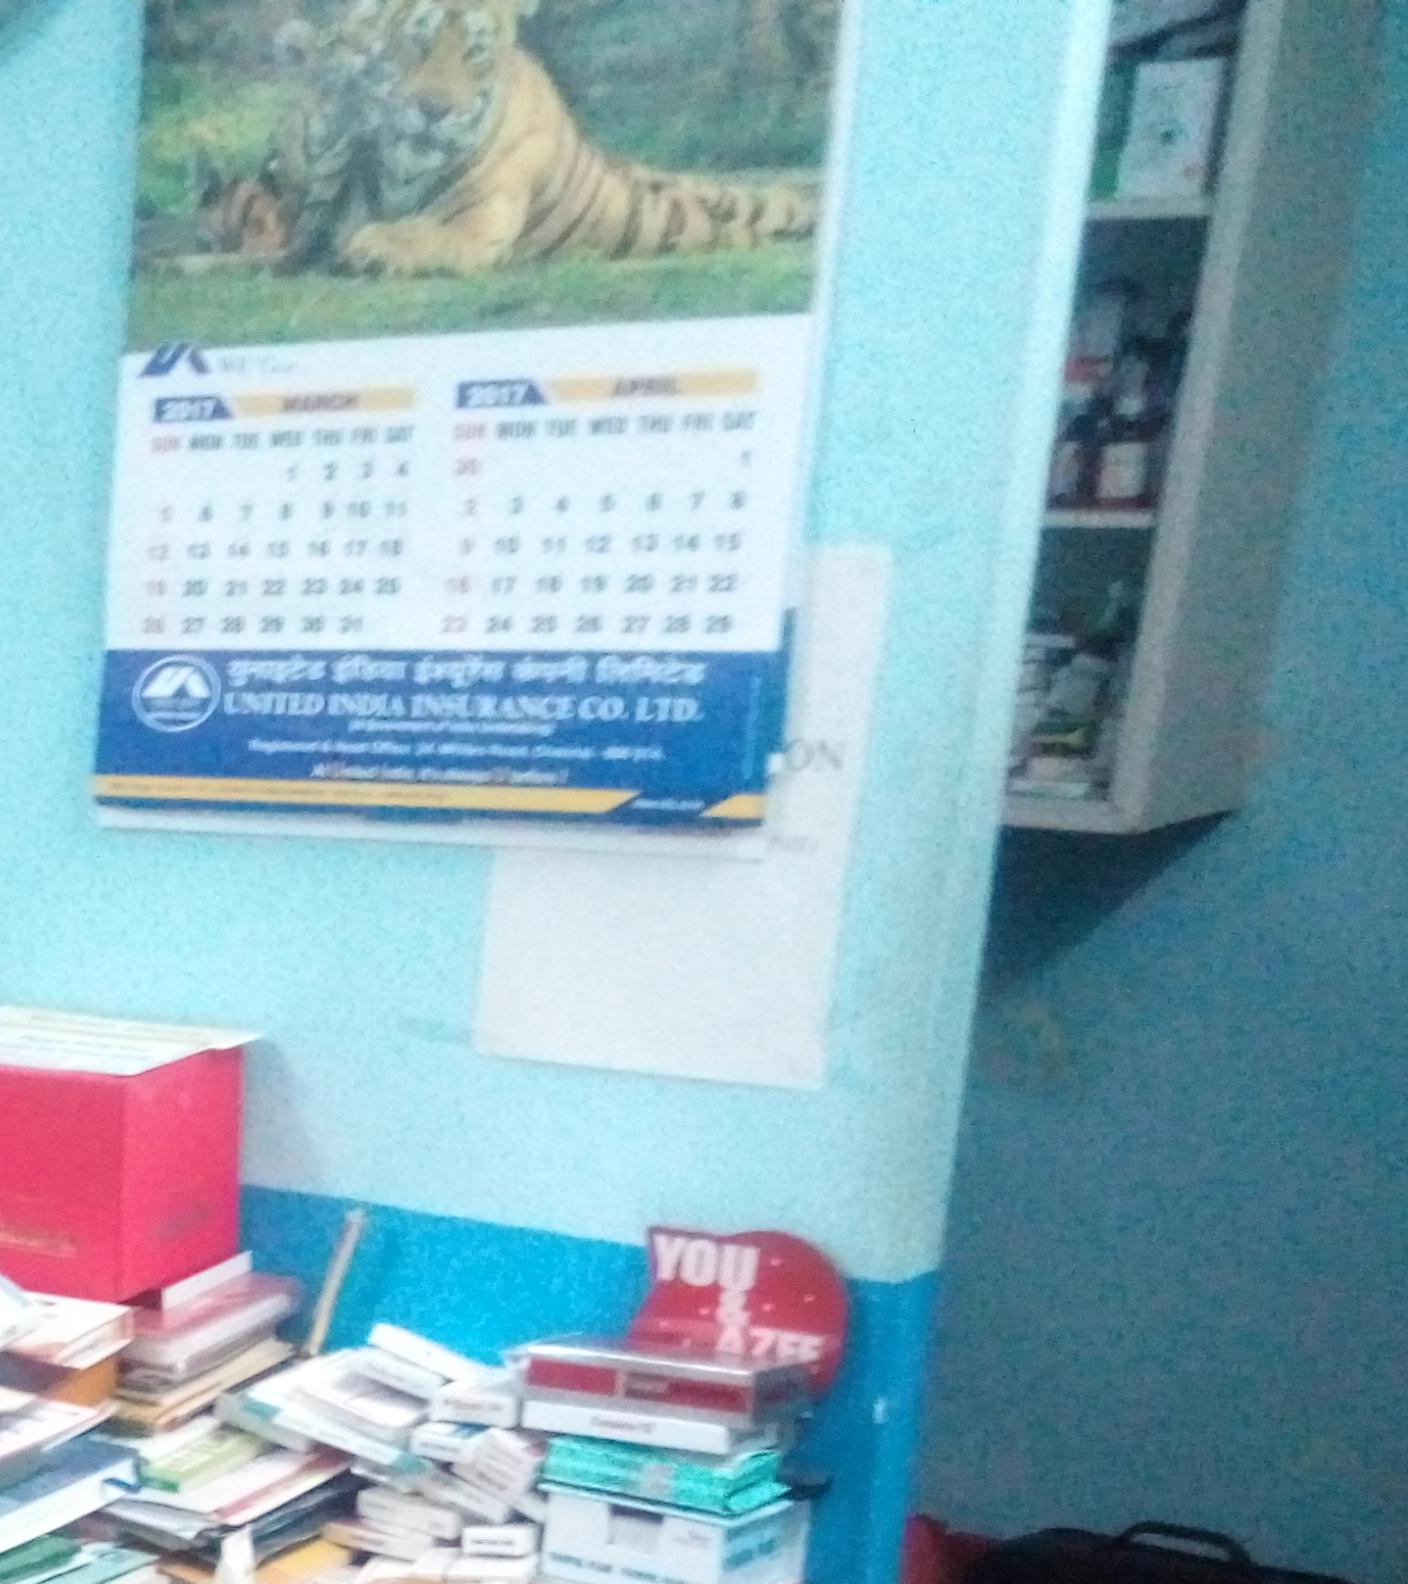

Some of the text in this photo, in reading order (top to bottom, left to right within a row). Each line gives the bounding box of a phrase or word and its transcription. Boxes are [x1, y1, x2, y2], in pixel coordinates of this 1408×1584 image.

[223, 691, 705, 722] UNITED INDIA INSURANCE CO. LTD.
[785, 738, 845, 773] ON
[654, 1234, 761, 1291] YOU
